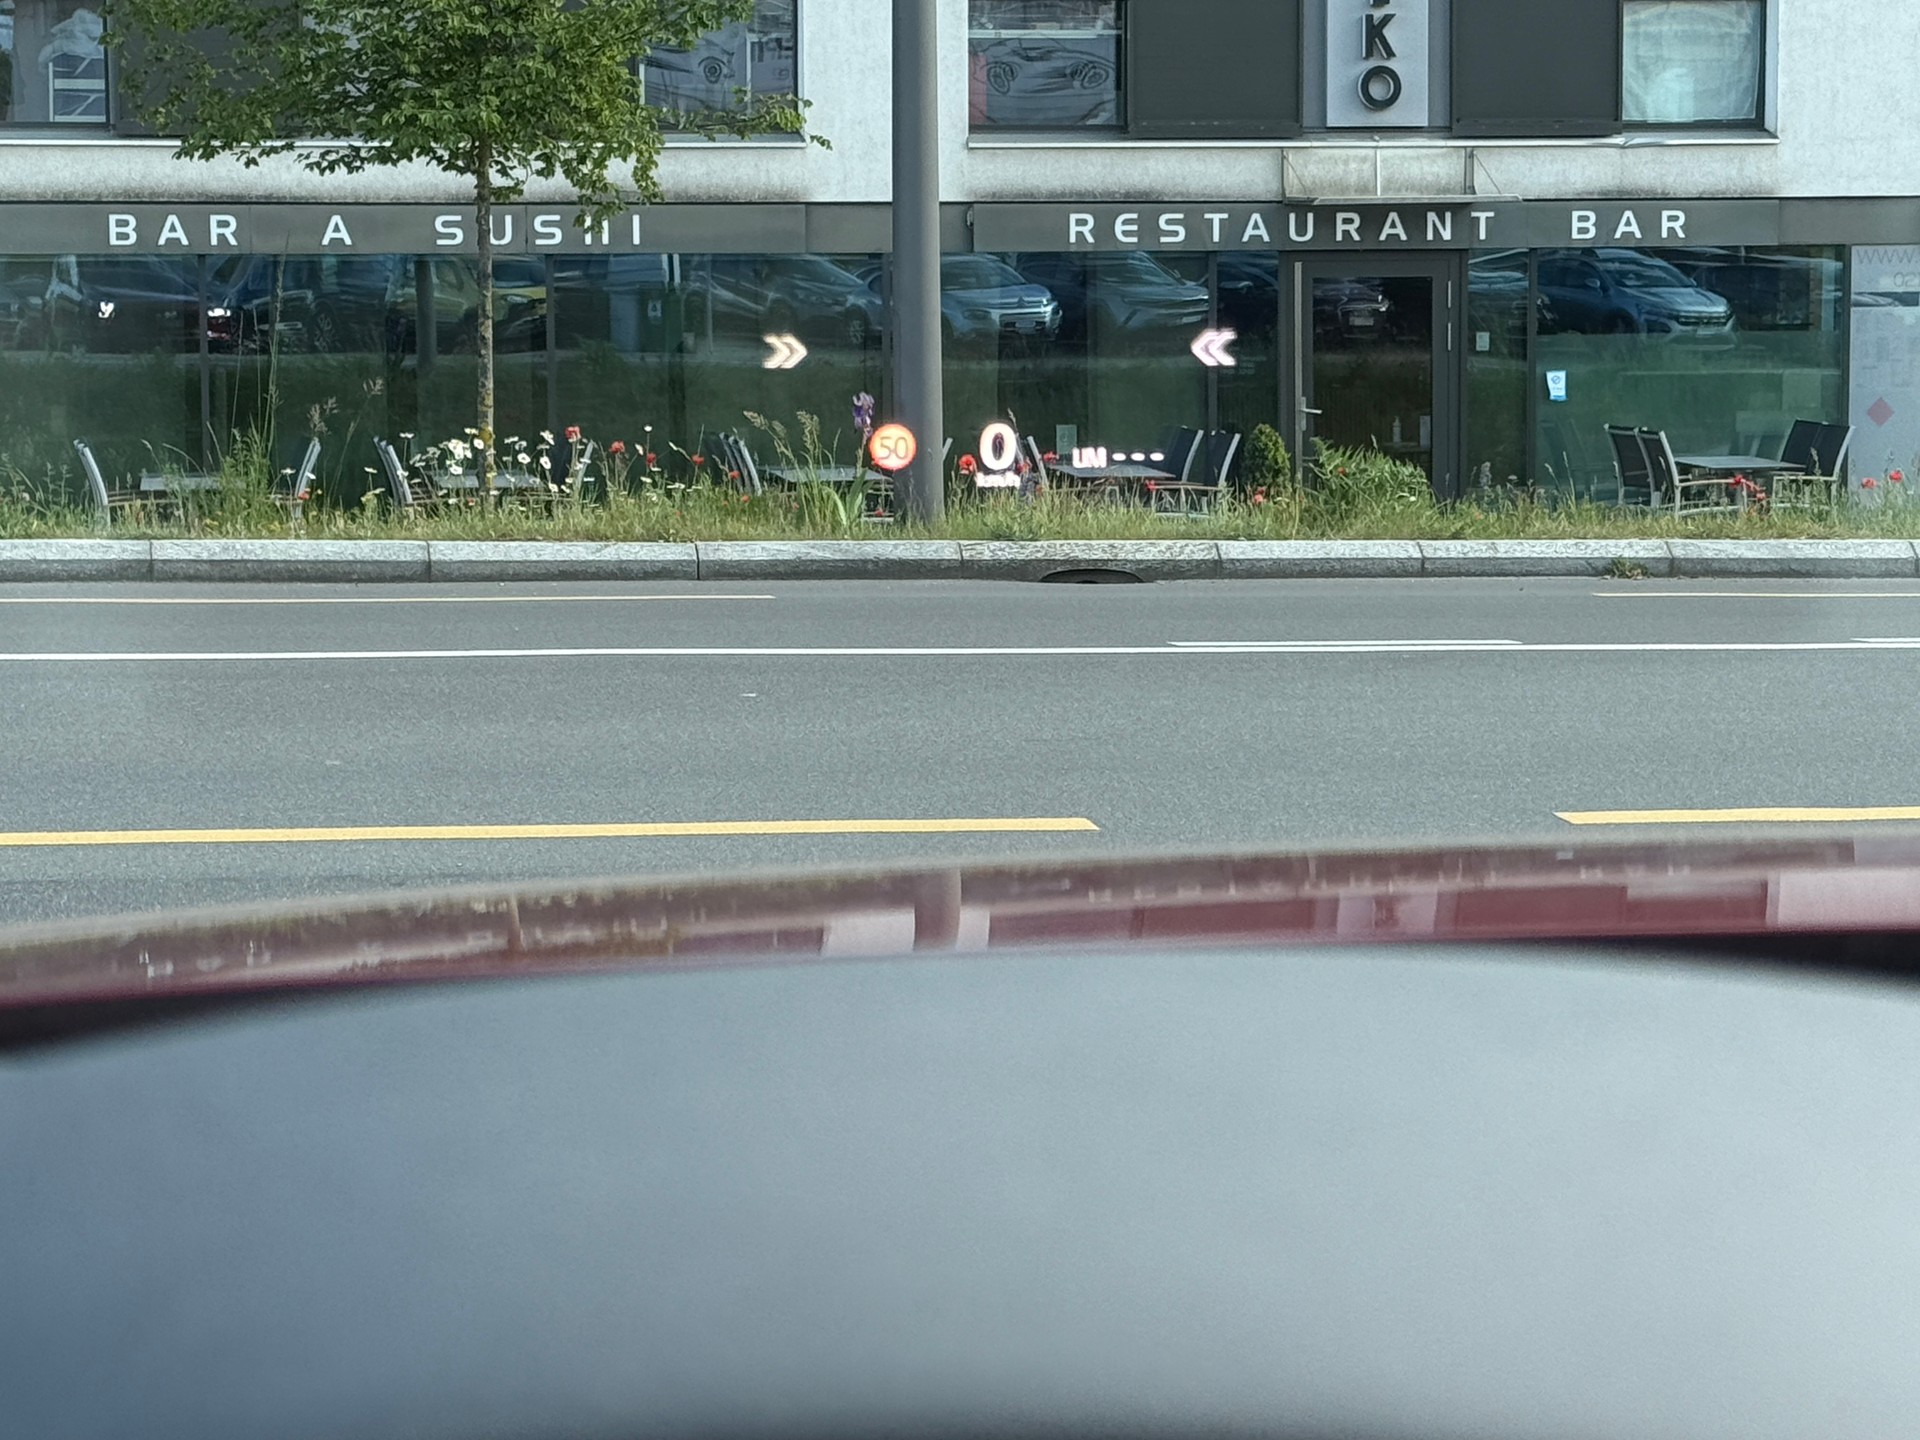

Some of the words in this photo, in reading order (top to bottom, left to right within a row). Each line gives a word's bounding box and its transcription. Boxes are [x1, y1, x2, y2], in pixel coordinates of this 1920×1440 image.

[1358, 0, 1402, 111] KO
[108, 214, 238, 246] BAR
[321, 214, 352, 246] A
[1069, 211, 1495, 243] RESTAURANT
[1571, 210, 1686, 239] BAR
[1893, 271, 1920, 288] 02
[878, 436, 909, 460] 50
[980, 422, 1018, 470] 0
